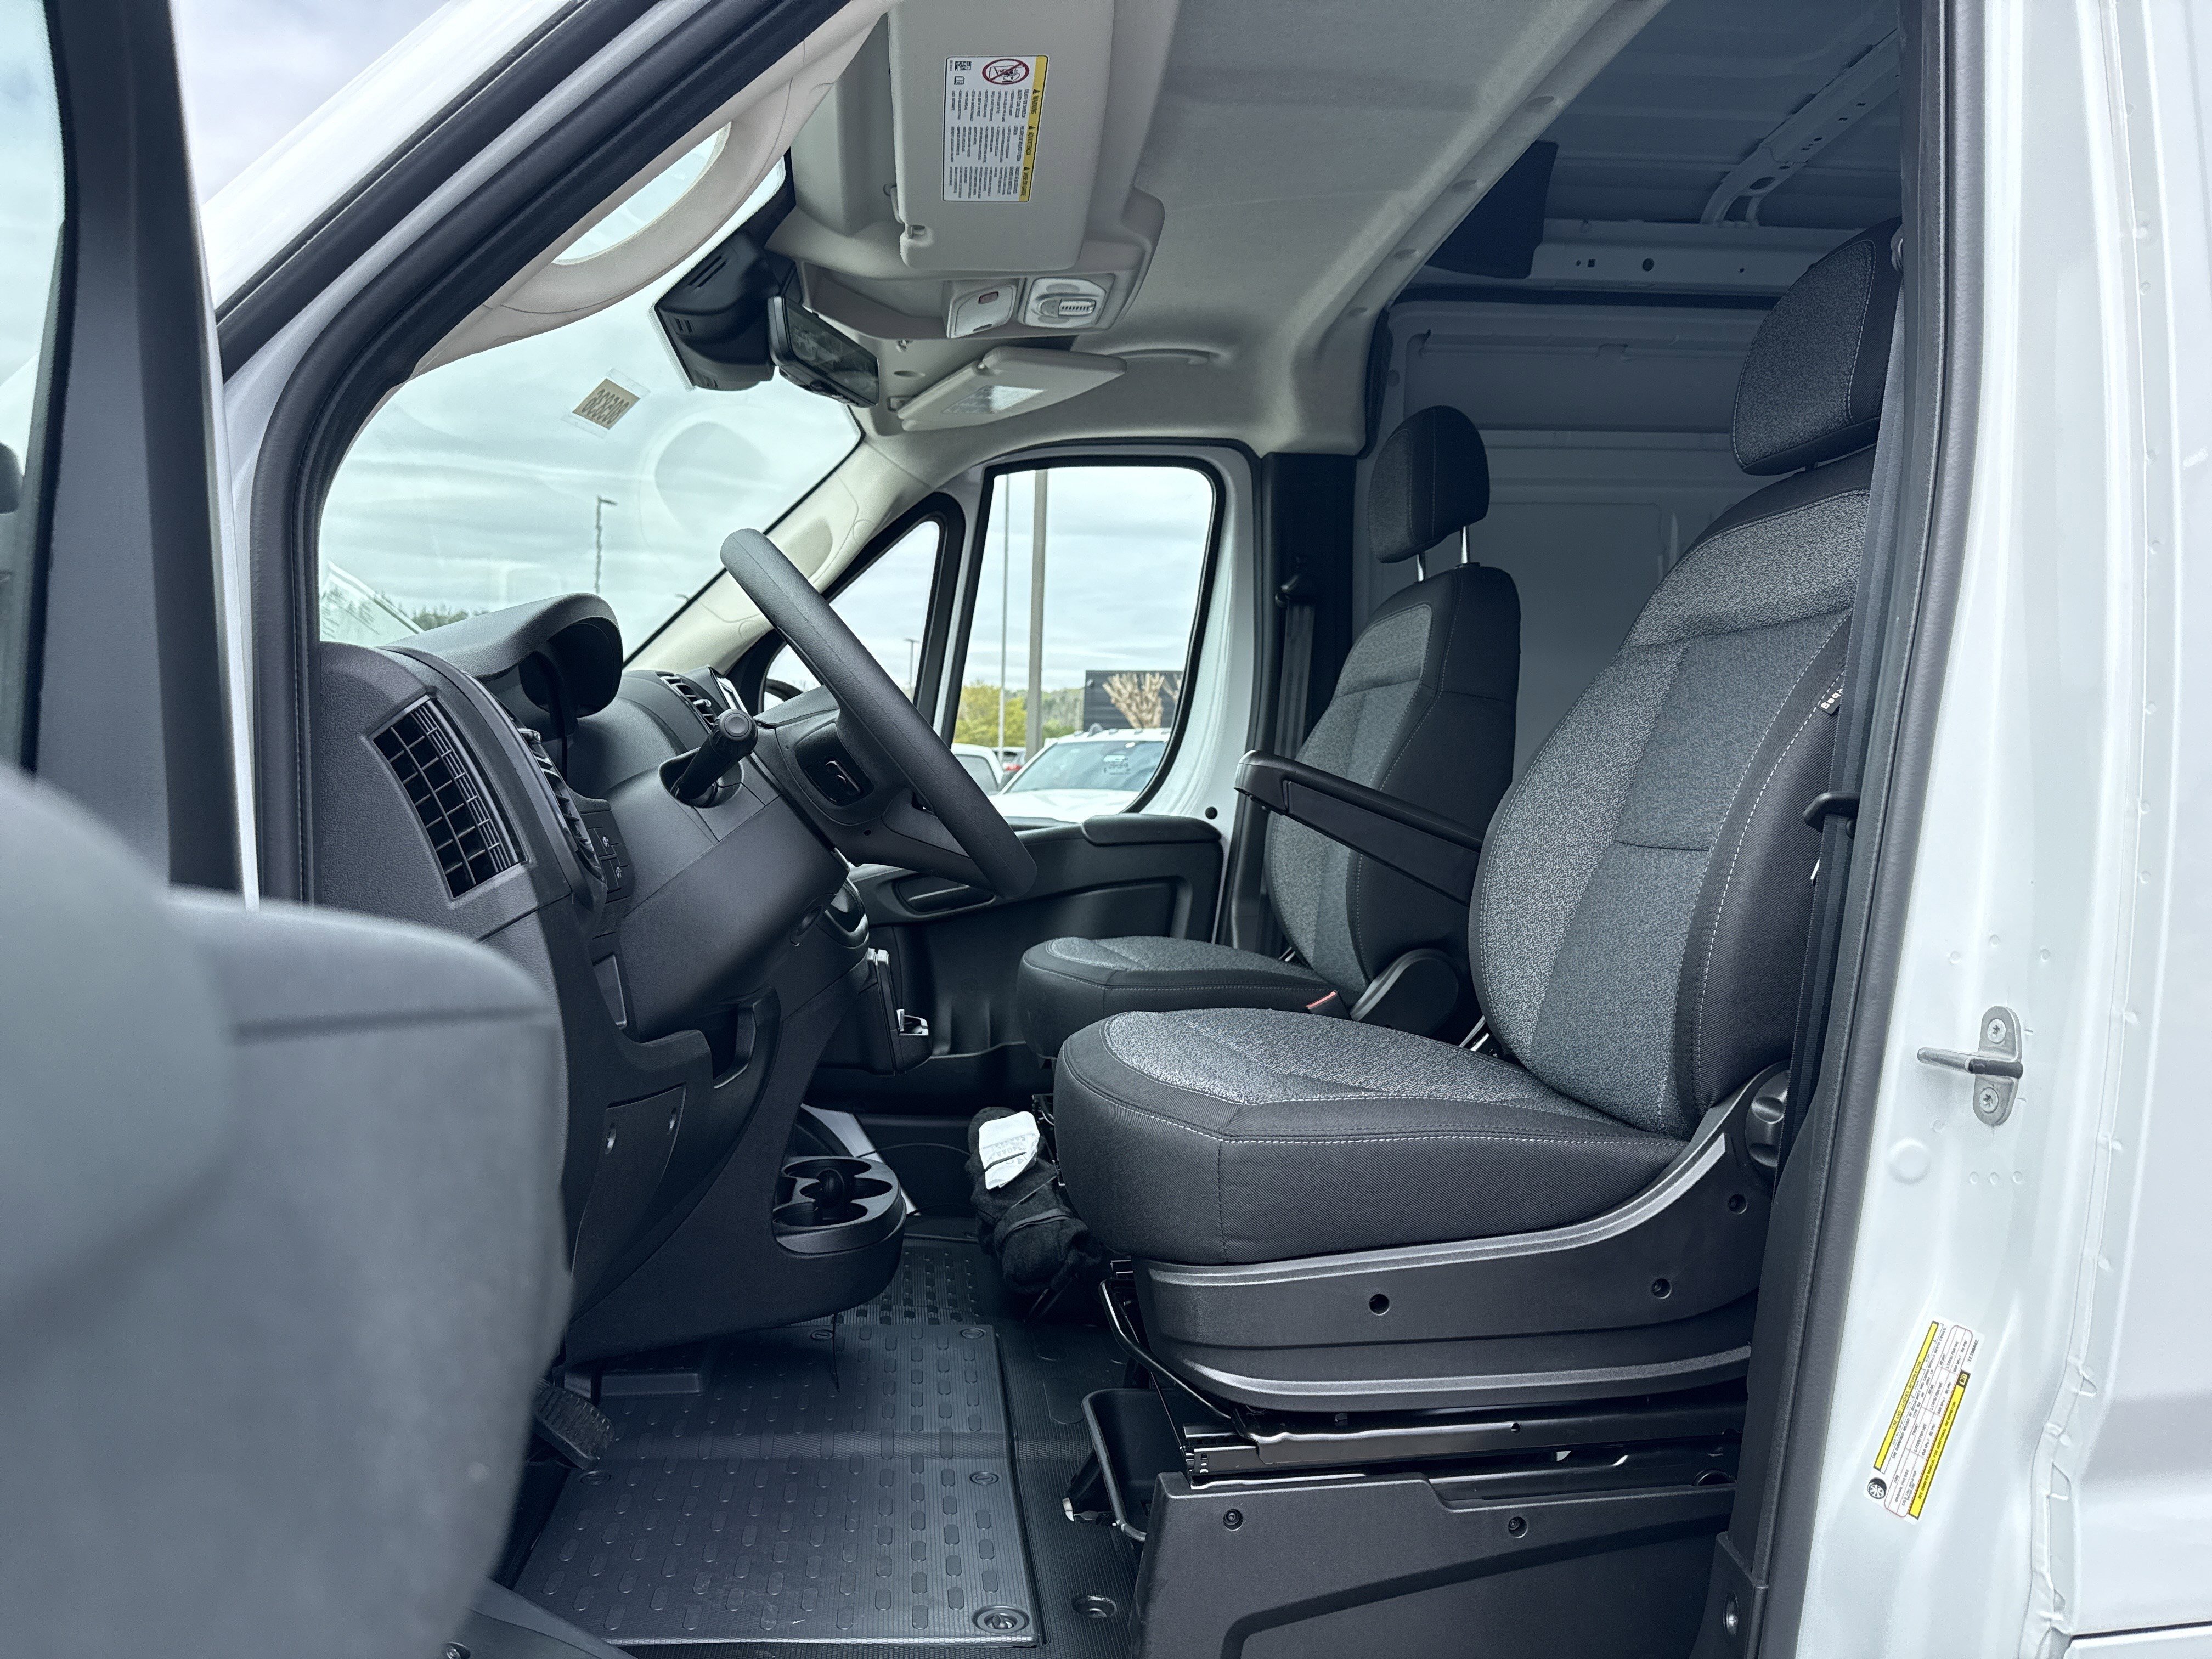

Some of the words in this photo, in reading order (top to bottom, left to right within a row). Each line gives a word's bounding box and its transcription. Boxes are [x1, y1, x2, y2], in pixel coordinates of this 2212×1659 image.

[1030, 95, 1039, 114] WARNING
[1899, 1390, 1910, 1409] LOADING
[1907, 1360, 1921, 1390] INFORMATION
